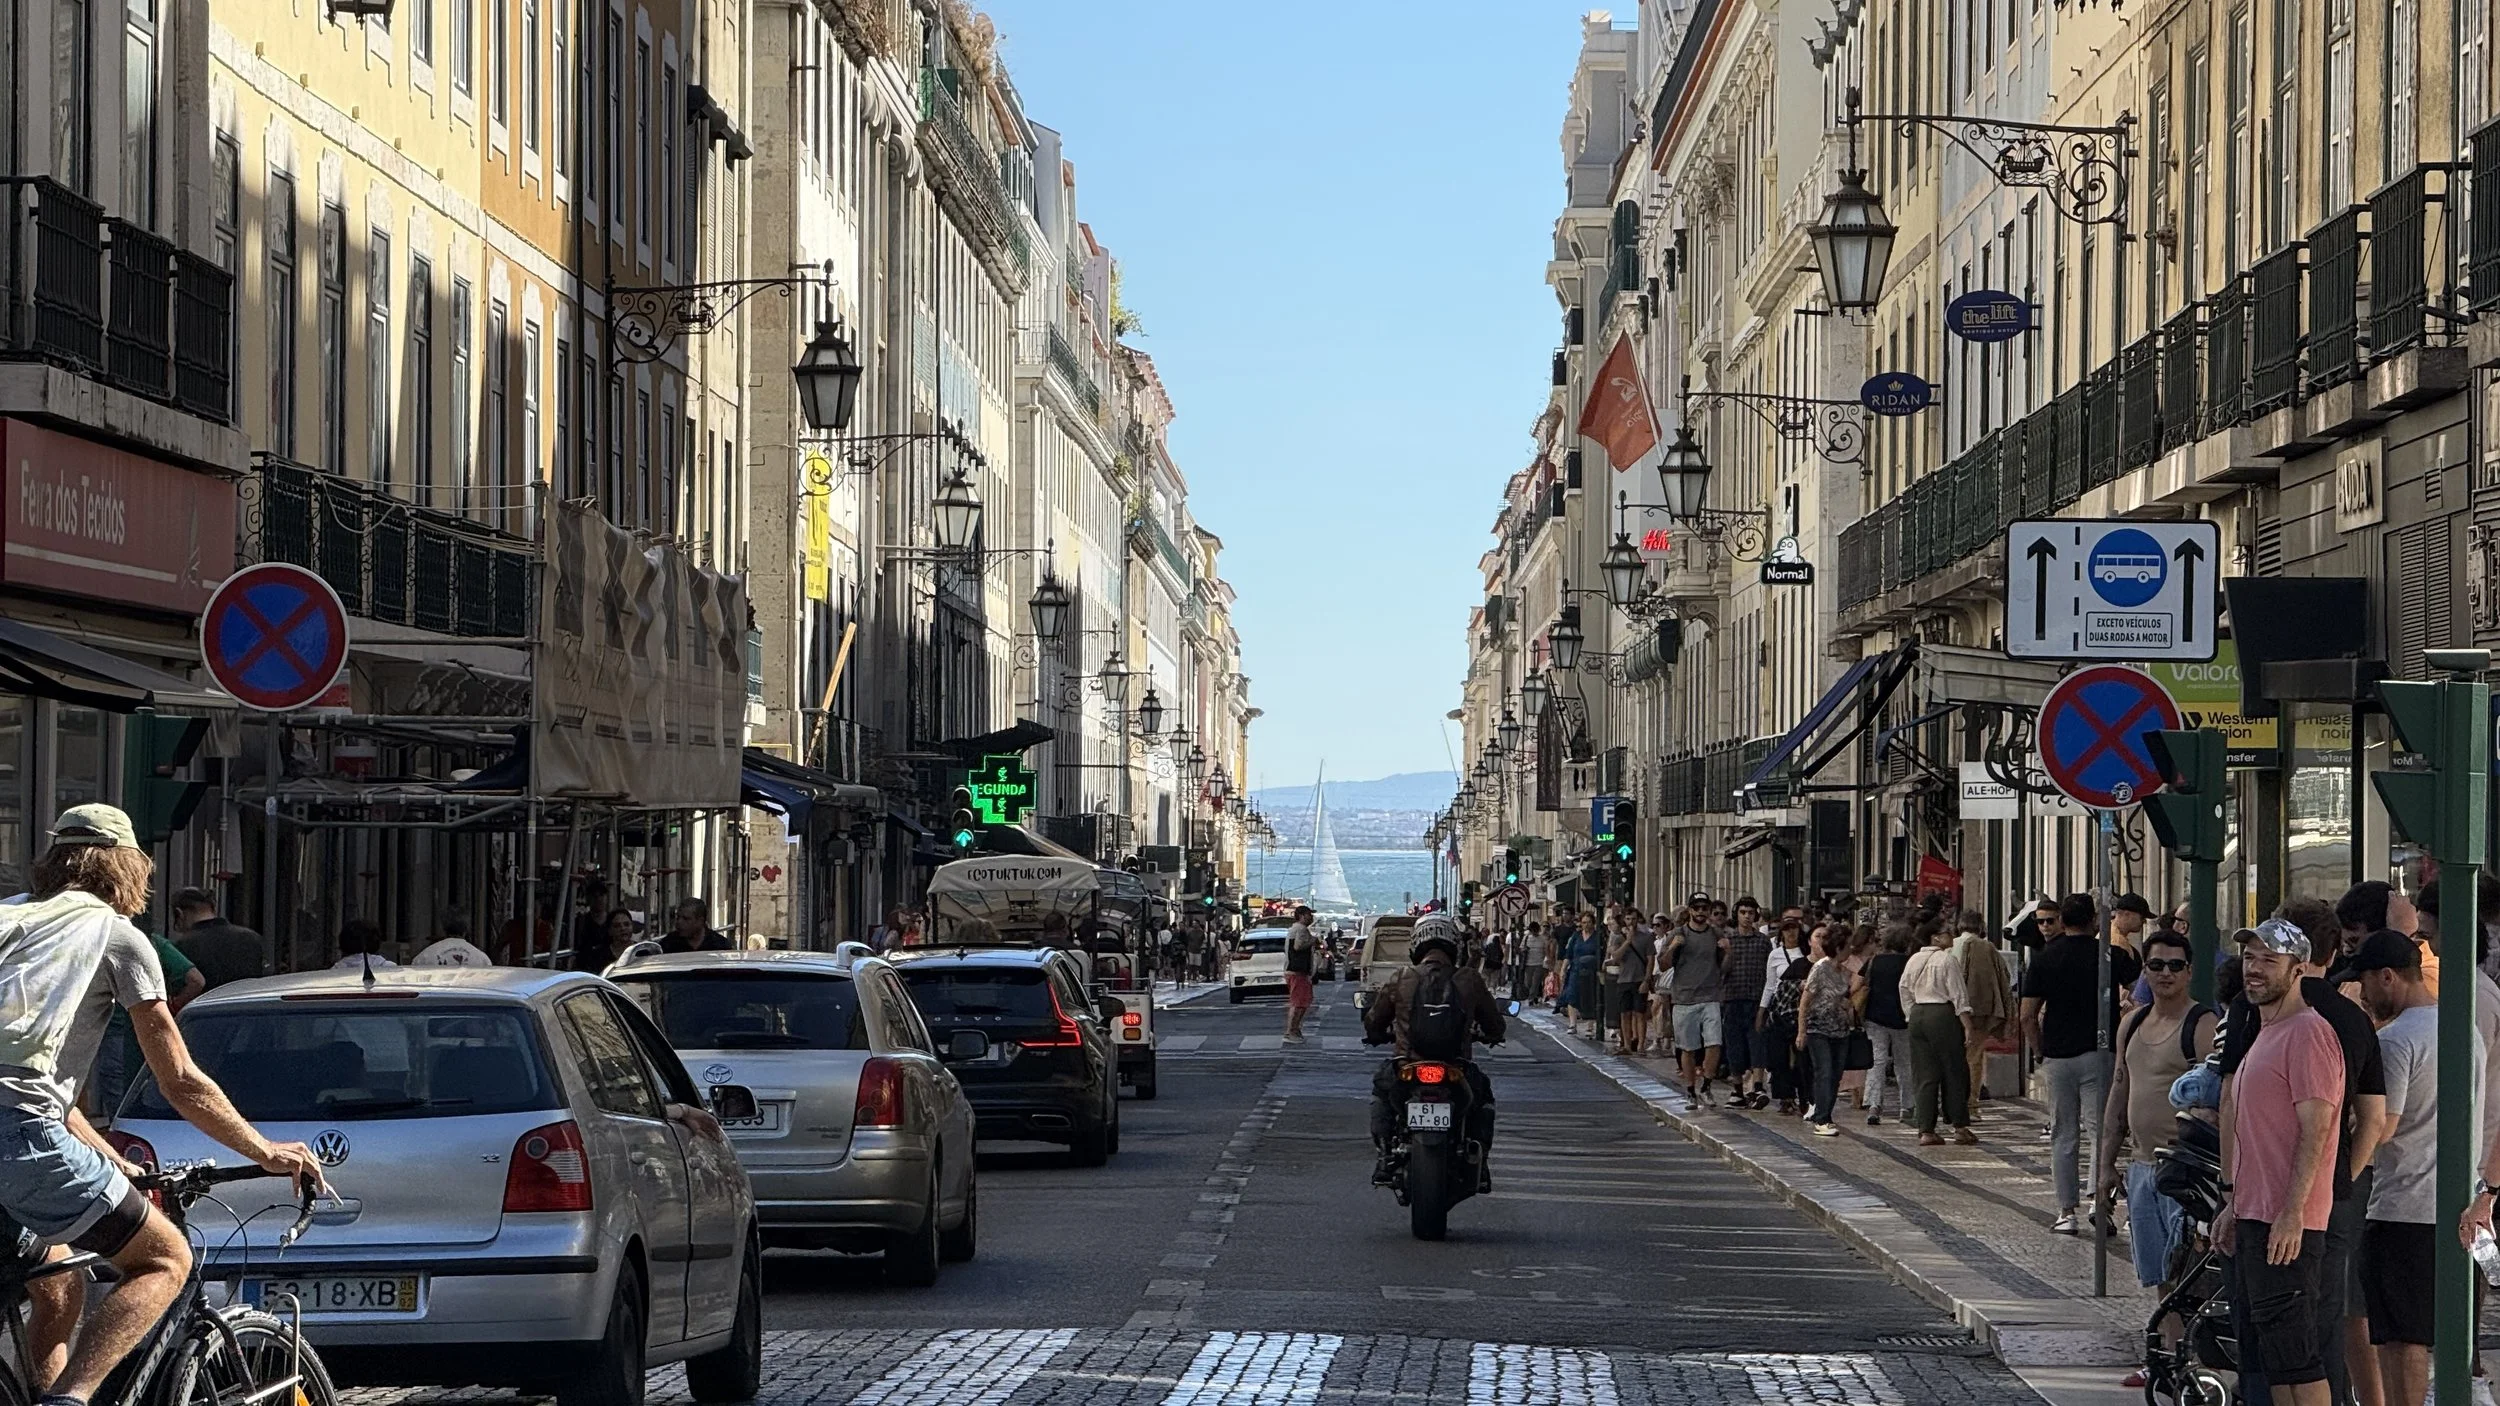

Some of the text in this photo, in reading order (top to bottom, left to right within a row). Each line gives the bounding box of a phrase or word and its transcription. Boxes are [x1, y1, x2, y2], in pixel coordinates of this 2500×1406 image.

[1962, 304, 2018, 325] the lift
[1871, 394, 1921, 406] RIDAN
[20, 459, 125, 546] Feira dos Tecidos
[1766, 567, 1808, 580] Normal
[2096, 615, 2161, 628] EXCETO VEÍCULOS
[2089, 631, 2168, 643] DUAS RODAS A MOTOR
[2207, 712, 2271, 725] Western
[2216, 726, 2252, 739] nion
[1966, 786, 2012, 796] ALE-HOP
[1421, 1104, 1435, 1114] 61
[1409, 1115, 1449, 1126] AT-80
